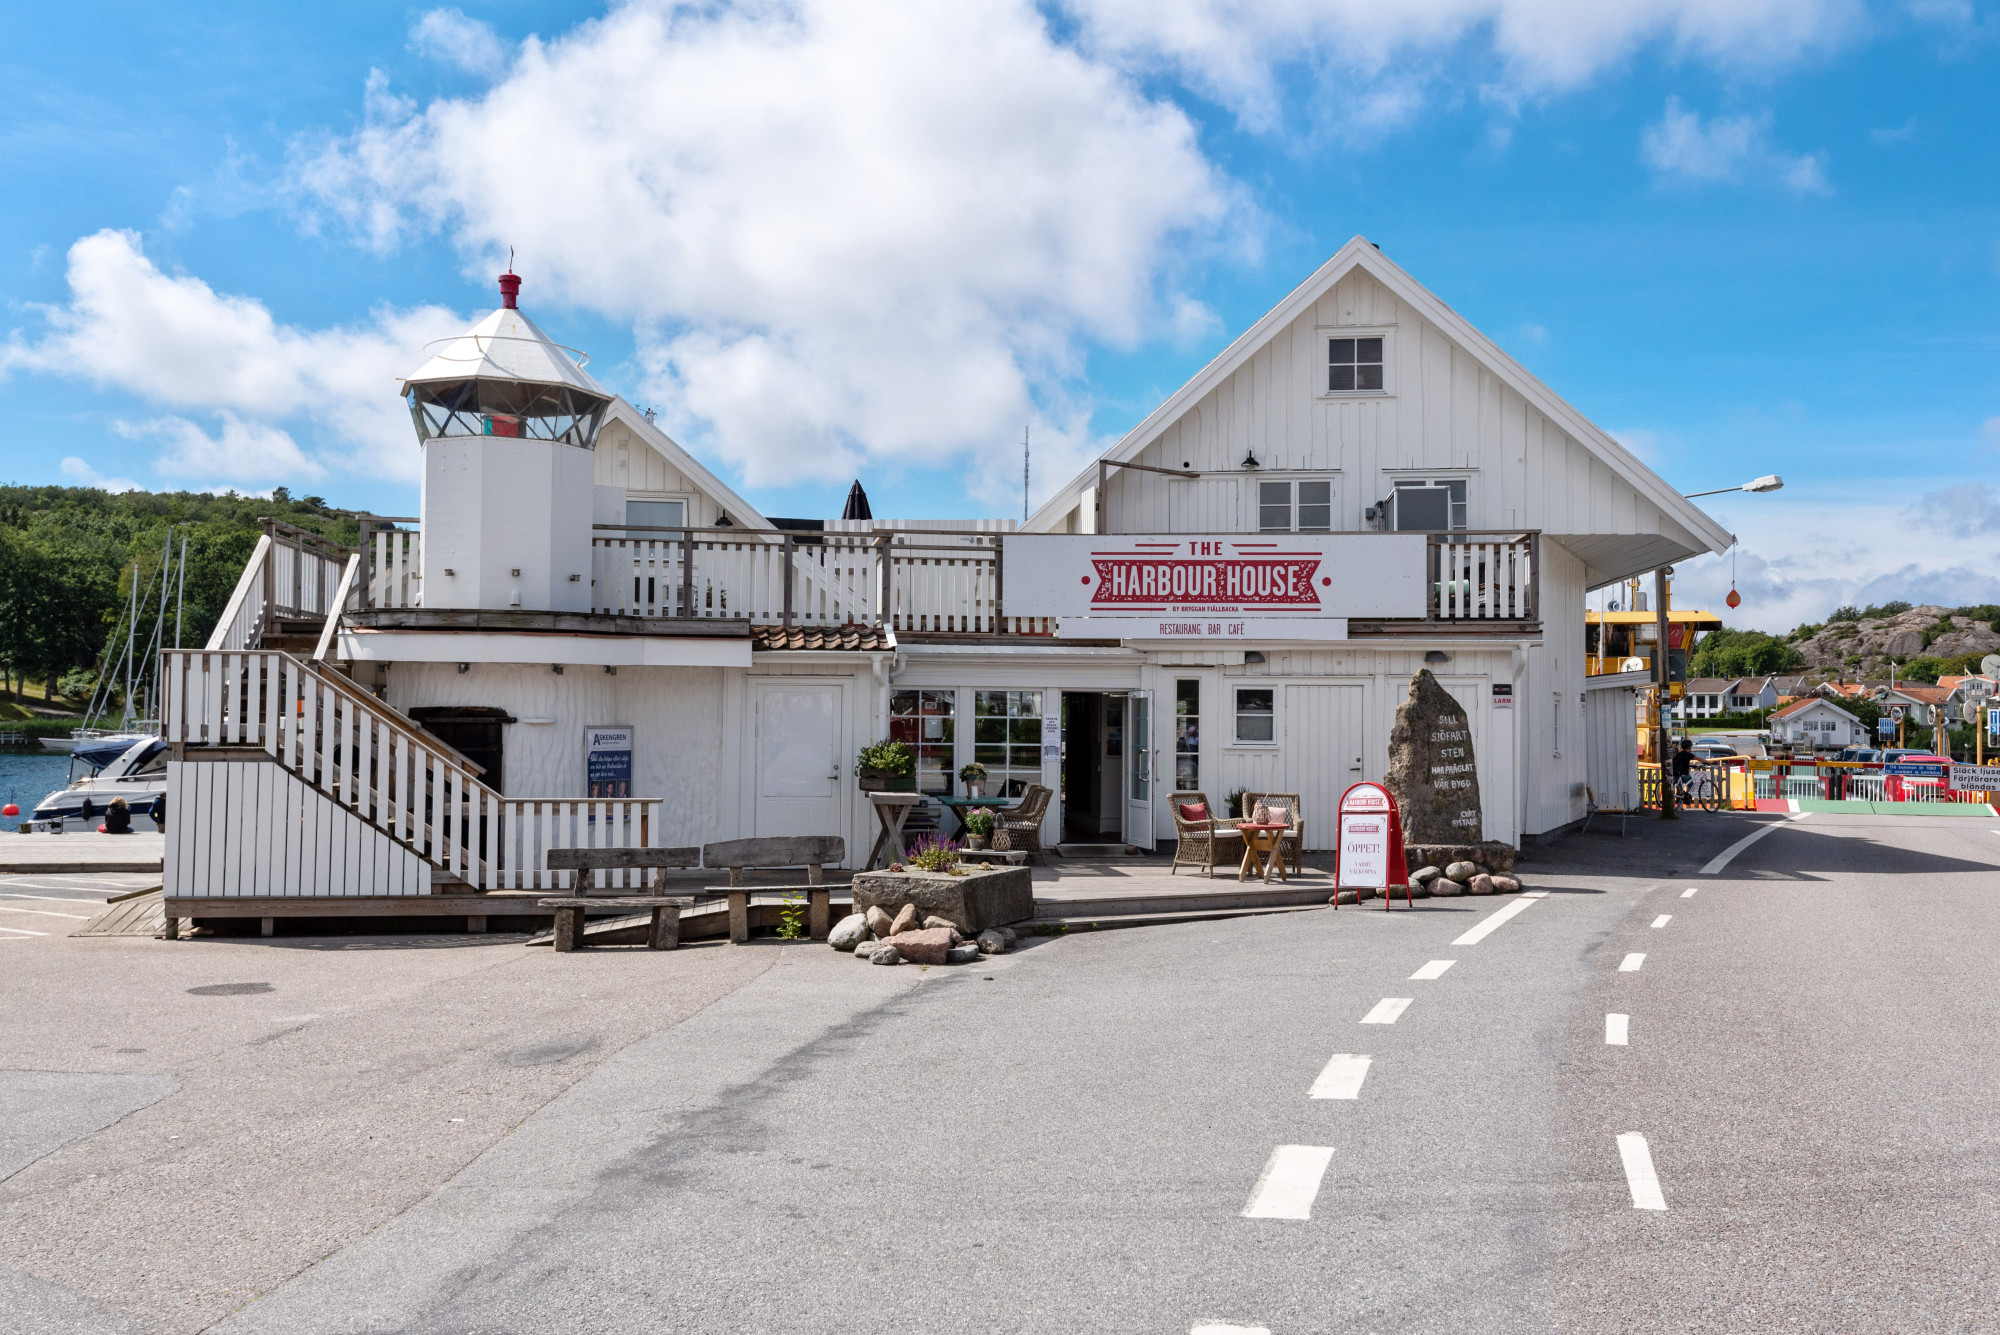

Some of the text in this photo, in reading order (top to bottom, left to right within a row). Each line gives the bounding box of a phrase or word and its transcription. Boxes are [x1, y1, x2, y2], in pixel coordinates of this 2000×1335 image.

[1188, 541, 1223, 556] THE
[1112, 565, 1300, 597] HARBOUR HOUSE
[1159, 623, 1201, 635] RESTAURANG
[1208, 623, 1221, 635] BAR
[1439, 714, 1459, 725] SILL
[593, 733, 627, 746] ASKENGREN
[1431, 729, 1468, 742] SJÖFART
[1441, 747, 1465, 758] STEN
[1434, 777, 1471, 789] VÅR BYGD
[1953, 774, 2000, 783] Färjförare
[1961, 782, 1996, 791] bländas
[1347, 841, 1380, 854] ÖPPET!
